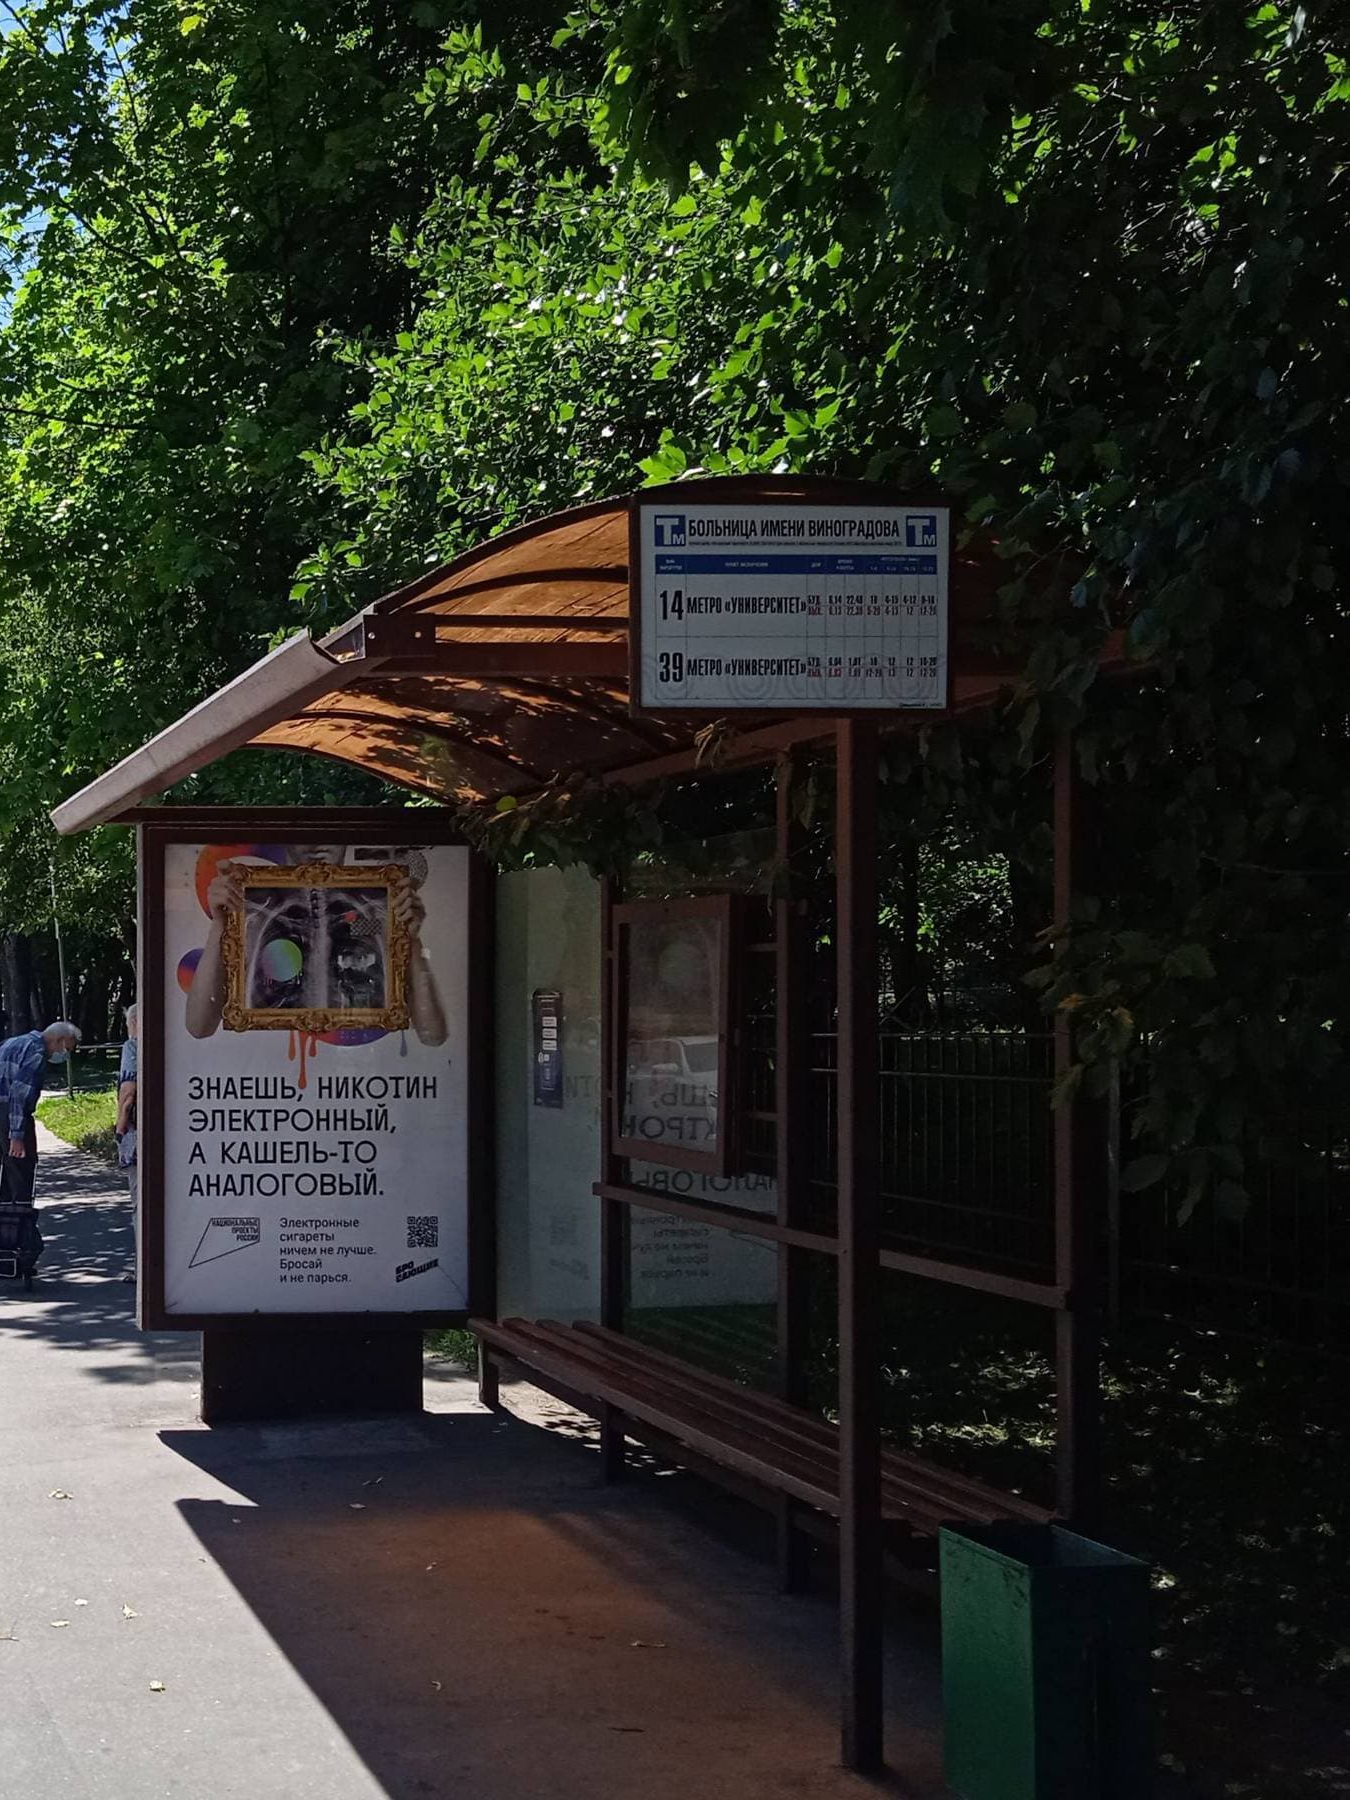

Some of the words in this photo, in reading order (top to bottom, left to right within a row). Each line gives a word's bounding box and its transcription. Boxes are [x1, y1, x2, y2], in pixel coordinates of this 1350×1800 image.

[688, 519, 757, 540] БОЛЬНИЦА
[761, 519, 804, 537] ИМЕНИ
[808, 519, 900, 540] ВИНОГРАДОВА
[660, 590, 684, 620] 14
[687, 596, 722, 614] МЕТРО
[725, 596, 806, 614] «УНИВЕРСИТЕТ»
[660, 652, 684, 683] 39
[687, 658, 722, 676] МЕТРО
[725, 658, 806, 676] «УНИВЕРСИТЕТ»
[189, 1076, 302, 1102] ЗНАЕШЬ,
[318, 1076, 437, 1099] НИКОТИН
[189, 1104, 397, 1134] ЭЛЕКТРОННЫЙ,
[189, 1142, 206, 1164] А
[221, 1140, 377, 1164] КАШЕЛЬ-ТО
[189, 1168, 384, 1197] АНАЛОГОВЫЙ.
[279, 1217, 360, 1229] Электронные
[279, 1232, 335, 1244] сигареты
[279, 1246, 317, 1256] ничем
[319, 1246, 334, 1256] не
[336, 1246, 377, 1258] лучше.
[279, 1258, 323, 1271] Бросай
[279, 1274, 288, 1283] и
[290, 1274, 304, 1283] не
[307, 1273, 352, 1286] парься.
